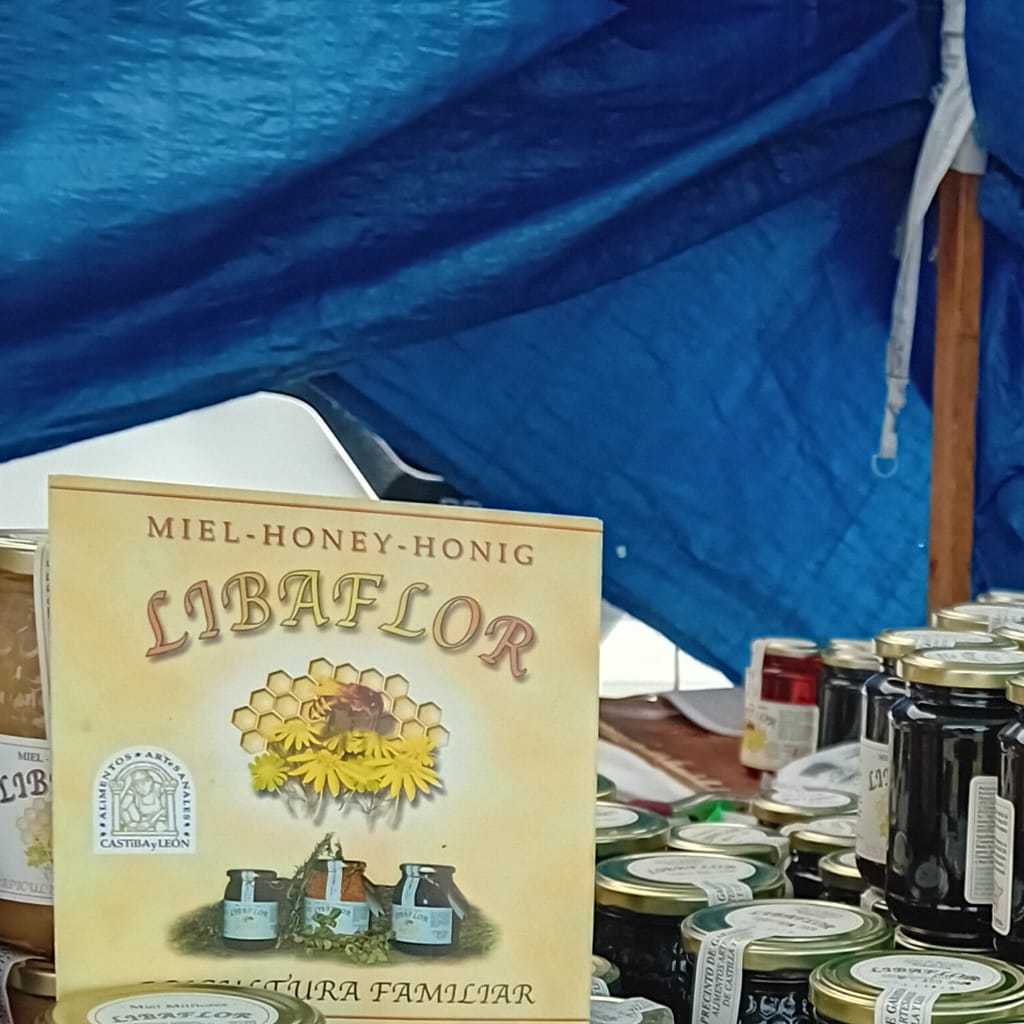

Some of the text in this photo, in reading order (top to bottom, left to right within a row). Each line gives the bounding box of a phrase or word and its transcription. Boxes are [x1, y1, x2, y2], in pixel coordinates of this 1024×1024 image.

[147, 515, 535, 567] MIEL-HONEY-HONIG
[145, 568, 539, 681] LIBAFLOR
[17, 751, 44, 763] MIEL
[99, 753, 133, 820] ALIMENTOS
[370, 980, 536, 1006] FAMILIAR
[111, 1010, 254, 1024] LIBAFLOR
